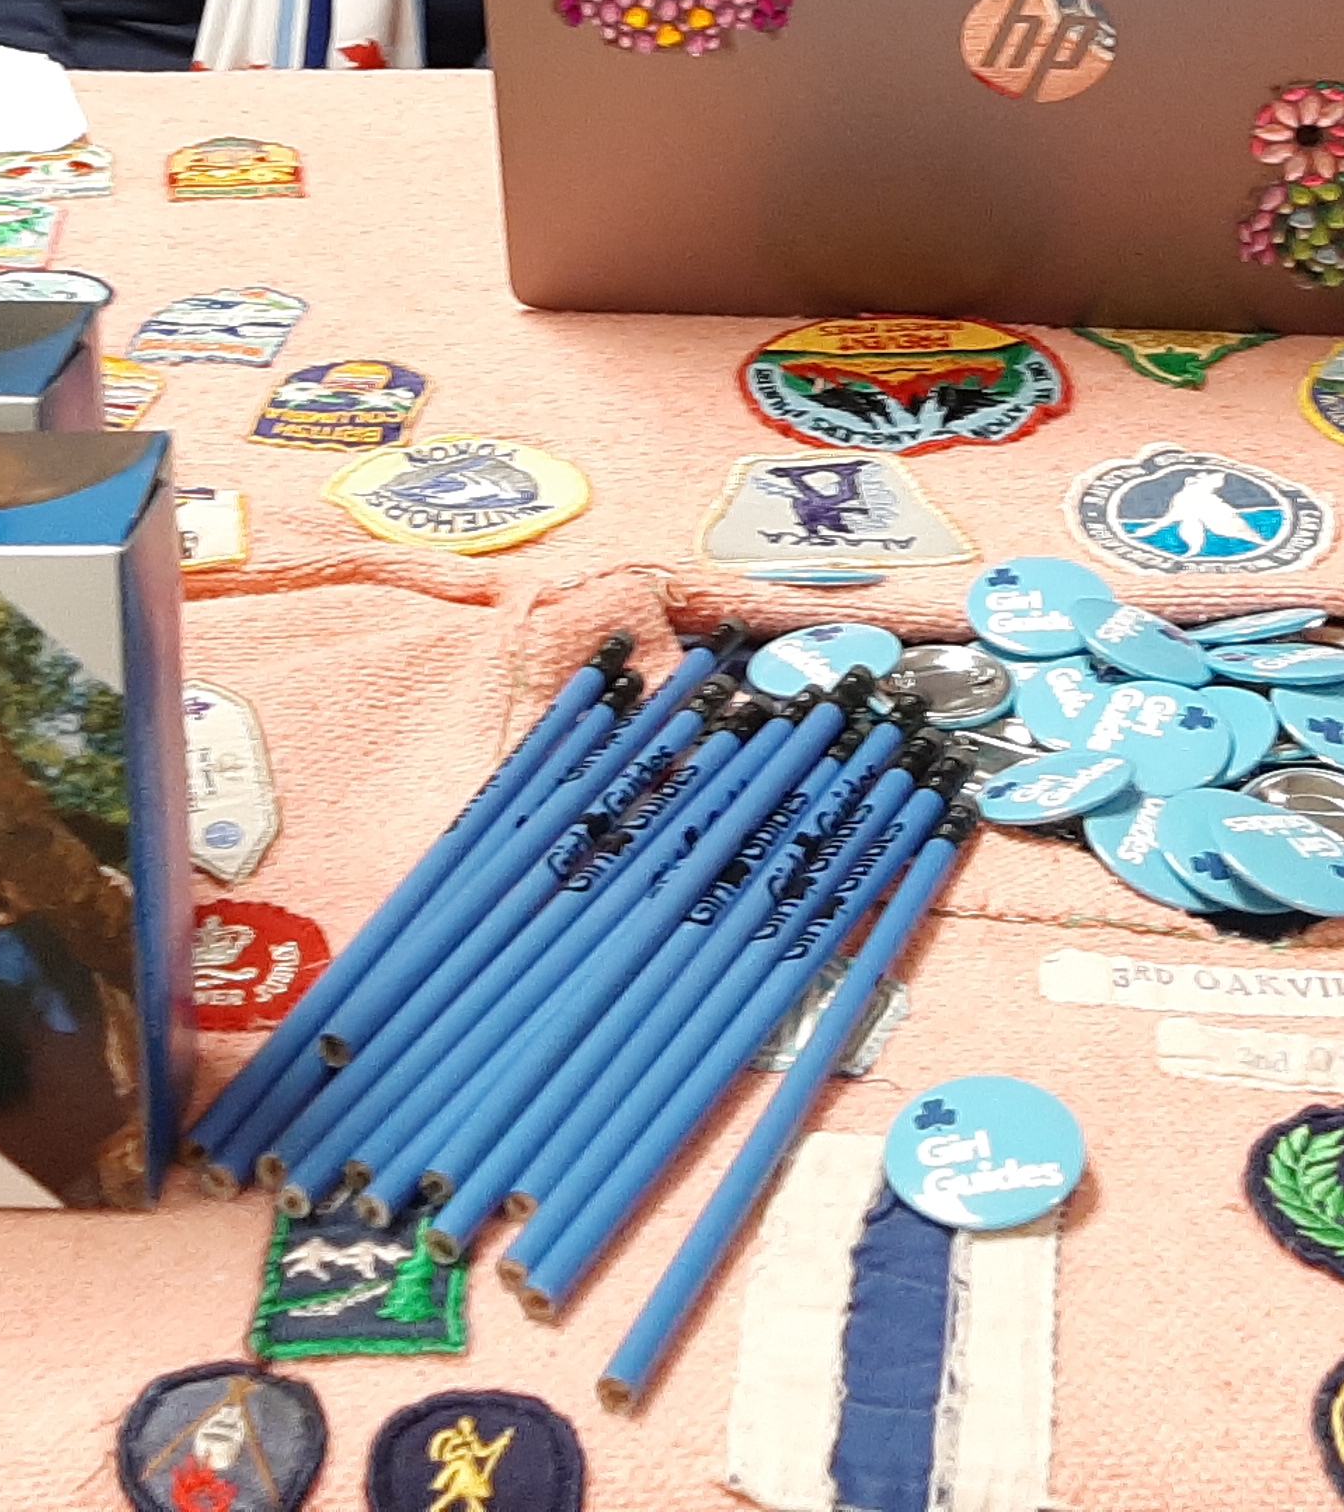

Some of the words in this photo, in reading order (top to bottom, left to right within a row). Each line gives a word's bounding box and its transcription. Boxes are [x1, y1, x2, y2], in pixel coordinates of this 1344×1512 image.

[352, 491, 556, 535] WHITEHORSE
[757, 530, 918, 553] ALASKA
[985, 589, 1044, 611] Girl
[987, 610, 1075, 634] Guide
[1037, 758, 1126, 807] Guides
[545, 830, 594, 882] Girl
[602, 745, 676, 818] Guides
[1111, 965, 1175, 989] 3RD
[916, 1129, 992, 1168] Girl
[922, 1158, 1065, 1197] Guides
